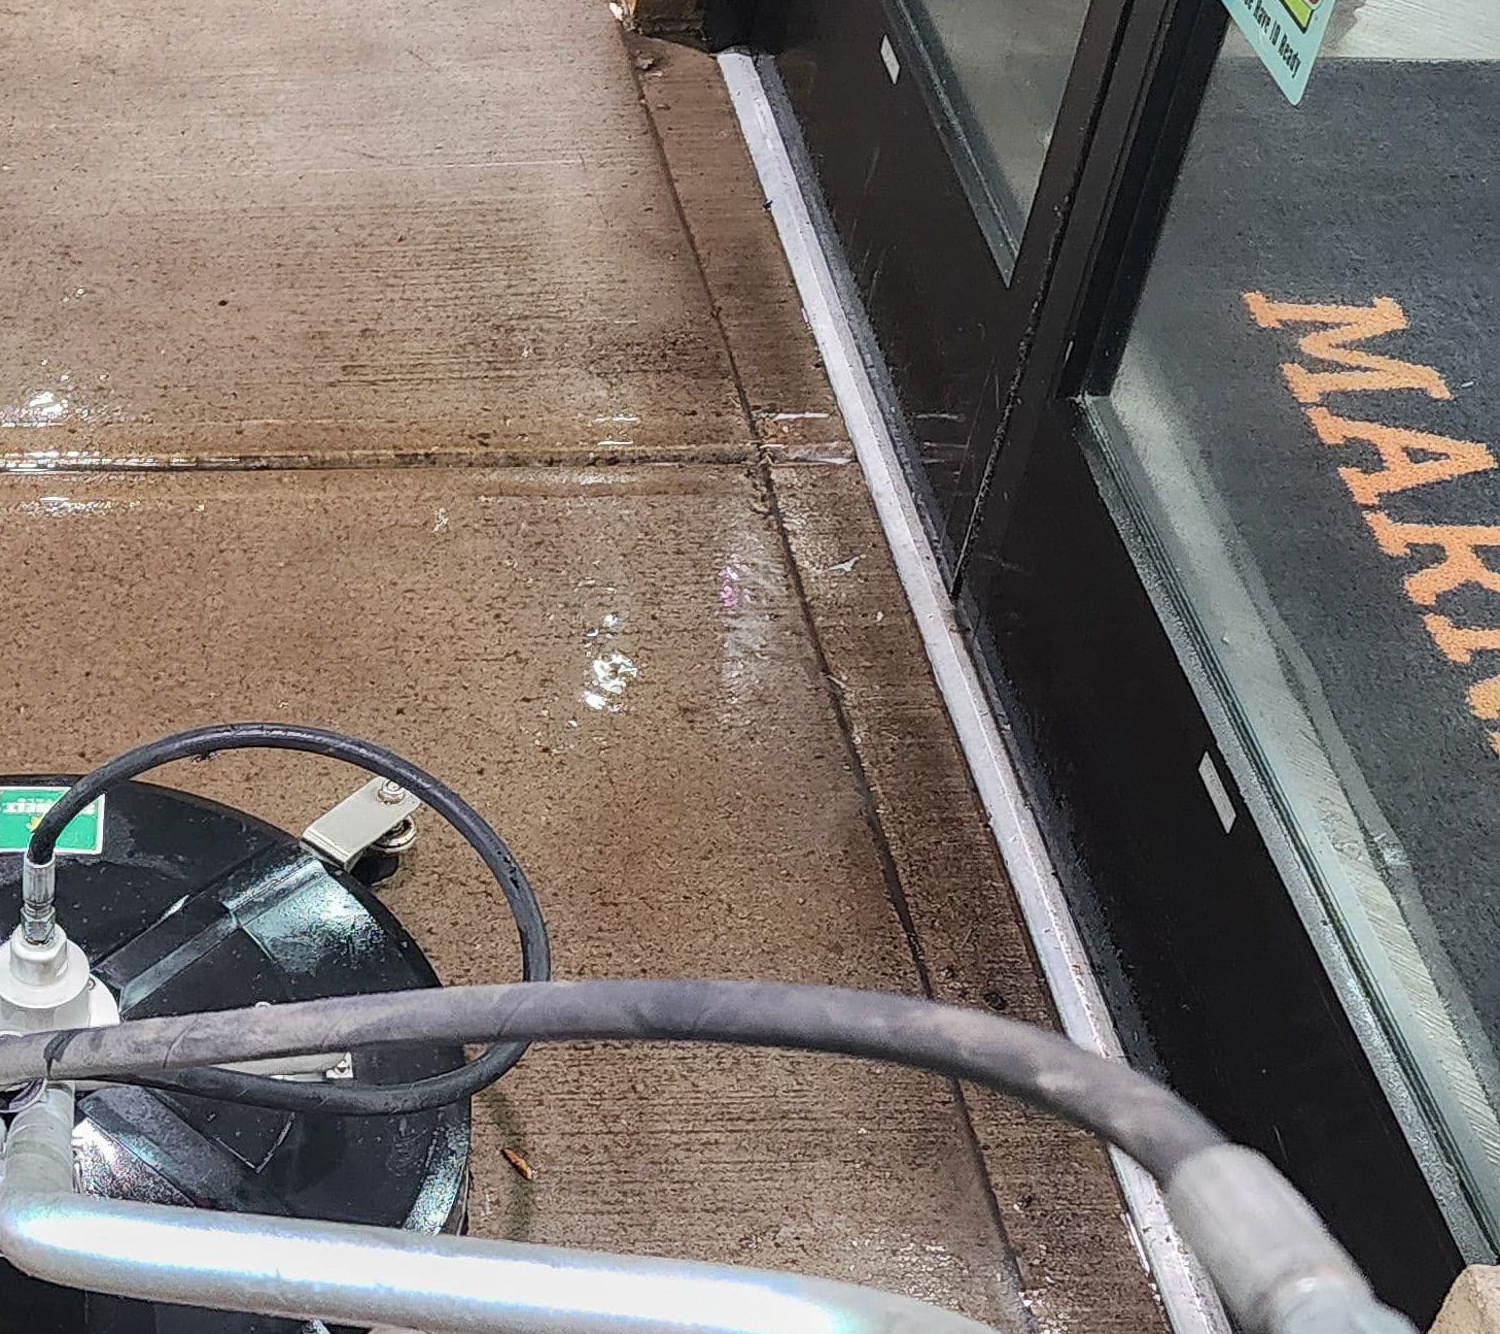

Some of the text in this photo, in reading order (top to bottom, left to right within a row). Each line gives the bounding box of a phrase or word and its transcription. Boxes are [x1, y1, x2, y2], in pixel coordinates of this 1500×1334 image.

[1270, 19, 1281, 47] ID
[1278, 34, 1301, 79] Ready
[1240, 290, 1500, 759] MAR
